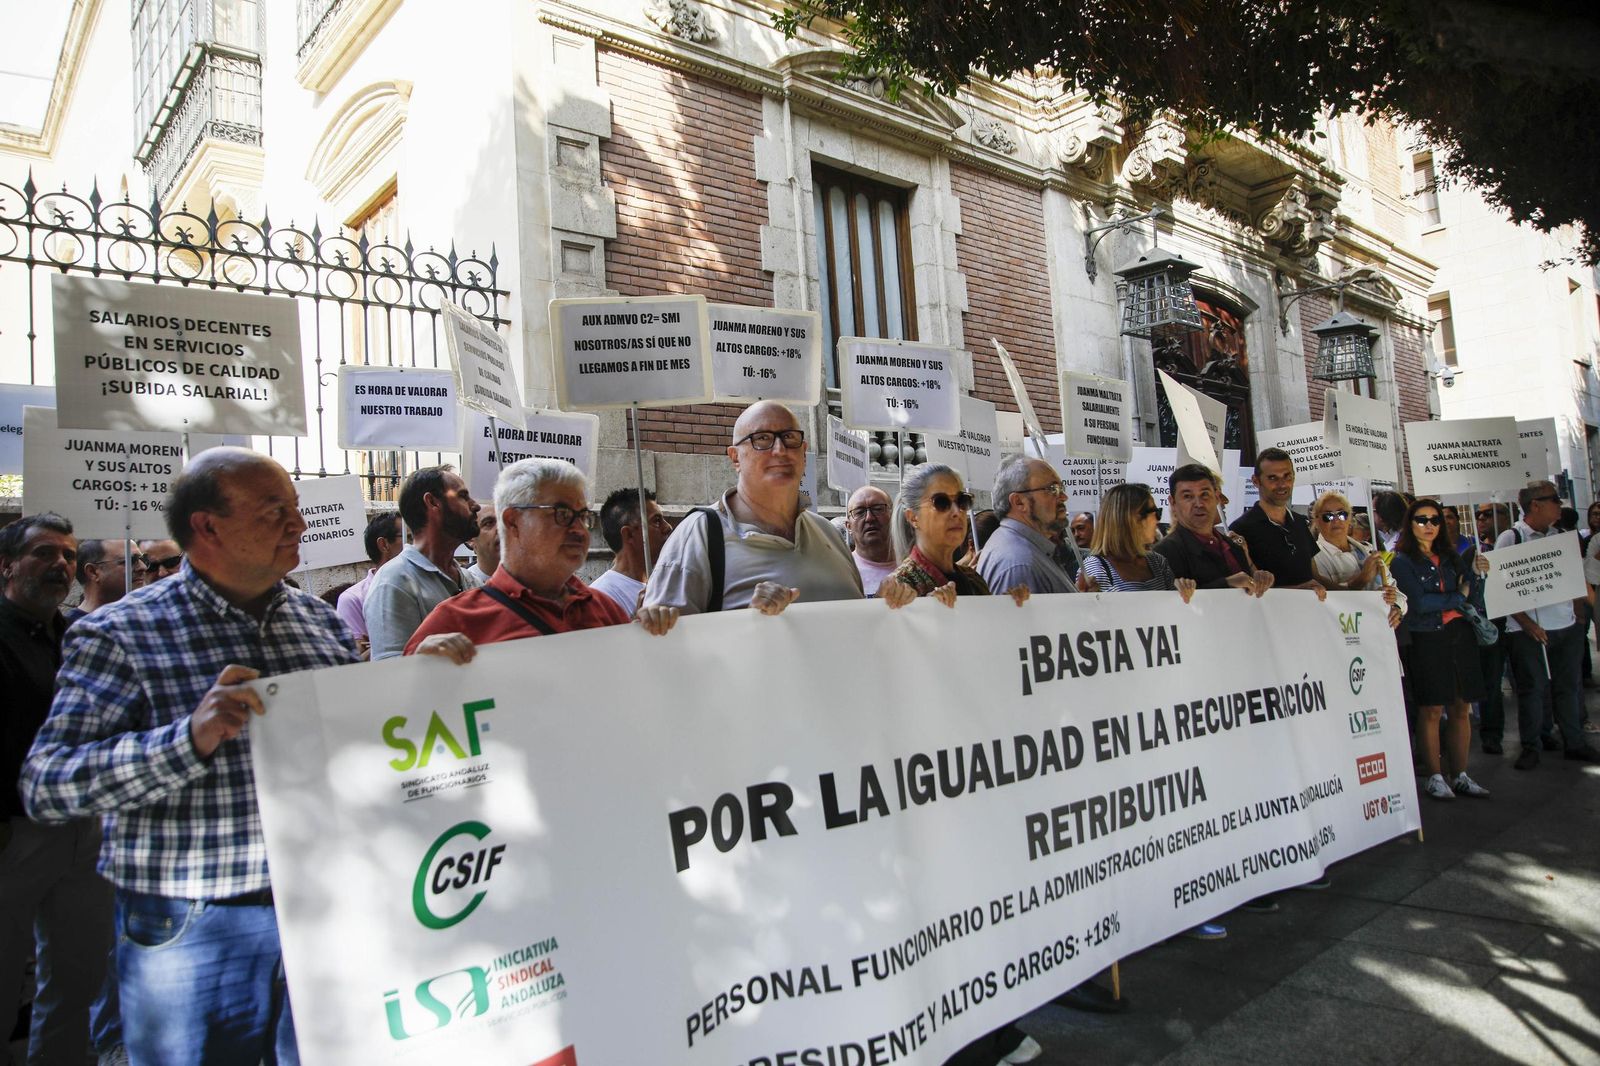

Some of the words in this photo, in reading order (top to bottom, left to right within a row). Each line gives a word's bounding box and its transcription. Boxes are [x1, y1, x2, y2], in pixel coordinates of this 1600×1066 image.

[89, 309, 180, 331] SALARIOS
[185, 318, 272, 338] DECENTES
[582, 314, 602, 327] AUX
[604, 313, 638, 326] ADMVO
[662, 312, 681, 324] SMI
[713, 320, 747, 335] JUANMA
[748, 323, 783, 337] MORENO
[784, 326, 791, 337] Y
[791, 327, 806, 339] SUS
[124, 335, 148, 350] EN
[153, 337, 244, 357] SERVICIOS
[574, 338, 644, 351] NOSOTROS/AS
[646, 334, 656, 349] SÍ
[658, 336, 676, 348] QUE
[678, 336, 691, 348] NO
[716, 341, 742, 354] ALTOS
[744, 344, 780, 358] CARGOS:
[781, 347, 802, 360] +18%
[84, 352, 178, 375] PÚBLICOS
[183, 362, 205, 376] DE
[209, 363, 280, 380] CALIDAD
[579, 361, 629, 375] LLEGAMOS
[631, 360, 638, 372] A
[639, 360, 655, 372] FIN
[656, 359, 669, 371] DE
[670, 358, 690, 371] MES
[856, 354, 888, 367] JUANMA
[889, 356, 921, 369] MORENO
[921, 359, 927, 369] Y
[928, 359, 943, 371] SUS
[743, 364, 755, 378] TÚ:
[756, 367, 777, 380] -16%
[102, 380, 177, 397] ¡SUBIDA
[182, 384, 268, 401] SALARIAL!
[355, 385, 366, 395] ES
[368, 385, 393, 396] HORA
[394, 386, 406, 396] DE
[408, 386, 447, 398] VALORAR
[861, 375, 885, 386] ALTOS
[886, 376, 920, 389] CARGOS:
[921, 378, 941, 391] +18%
[1077, 386, 1098, 398] JUANMA
[360, 406, 402, 416] NUESTRO
[404, 406, 443, 417] TRABAJO
[886, 396, 900, 408] TÚ:
[900, 398, 919, 410] -16%
[1084, 418, 1088, 427] A
[498, 428, 524, 441] HORA
[527, 430, 538, 442] DE
[540, 431, 582, 446] VALORAR
[966, 431, 992, 443] VALORAR
[1286, 435, 1318, 446] AUXILIAR
[1518, 431, 1543, 439] ENTES
[64, 440, 126, 454] JUANMA
[938, 439, 965, 452] NUESTRO
[966, 445, 991, 457] TRABAJO
[1427, 441, 1460, 451] JUANMA
[1461, 438, 1502, 449] MALTRATA
[1433, 450, 1498, 461] SALARIALMENTE
[85, 460, 94, 471] Y
[98, 461, 126, 473] SUS
[129, 463, 172, 475] ALTOS
[1309, 463, 1318, 471] DE
[1319, 461, 1335, 469] MES
[1432, 464, 1448, 472] SUS
[1450, 460, 1511, 471] FUNCIONARIOS
[72, 479, 137, 492] CARGOS:
[152, 483, 167, 493] 18
[94, 496, 119, 511] TÚ:
[131, 501, 148, 511] 16
[1499, 559, 1529, 571] JUANMA
[1529, 550, 1562, 564] MORENO
[1516, 566, 1530, 577] SUS
[1530, 562, 1554, 574] ALTOS
[1505, 577, 1538, 590] CARGOS:
[1019, 629, 1134, 695] ¡BASTA
[1136, 625, 1181, 668] YA!
[382, 698, 496, 772] SAF
[1359, 758, 1385, 779] CCOO
[669, 781, 798, 873] POR
[819, 764, 890, 829] LA
[894, 726, 1084, 811] IGUALDAD
[1092, 715, 1130, 763] EN
[1137, 708, 1170, 751] LA
[1025, 766, 1207, 861] RETRIBUTIVA
[1363, 798, 1380, 820] UGT
[432, 843, 507, 895] CSIF
[1174, 861, 1240, 909] PERSONAL
[686, 964, 842, 1048] PERSONAL
[851, 906, 984, 987] FUNCIONARIO
[990, 894, 1015, 926] DE
[1019, 886, 1040, 916] LA
[1044, 836, 1165, 905] ADMINISTRACIÓN
[1167, 819, 1220, 855] GENERAL
[1222, 811, 1238, 834] DE
[1239, 806, 1252, 827] LA
[1255, 795, 1300, 823] JUNTA
[493, 936, 559, 972] INICIATIVA
[497, 957, 555, 990] SINDICAL
[927, 1001, 938, 1033] Y
[941, 970, 998, 1025] ALTOS
[1003, 933, 1080, 989] CARGOS:
[1083, 911, 1121, 948] +18%
[501, 973, 565, 1008] ANDALUZA
